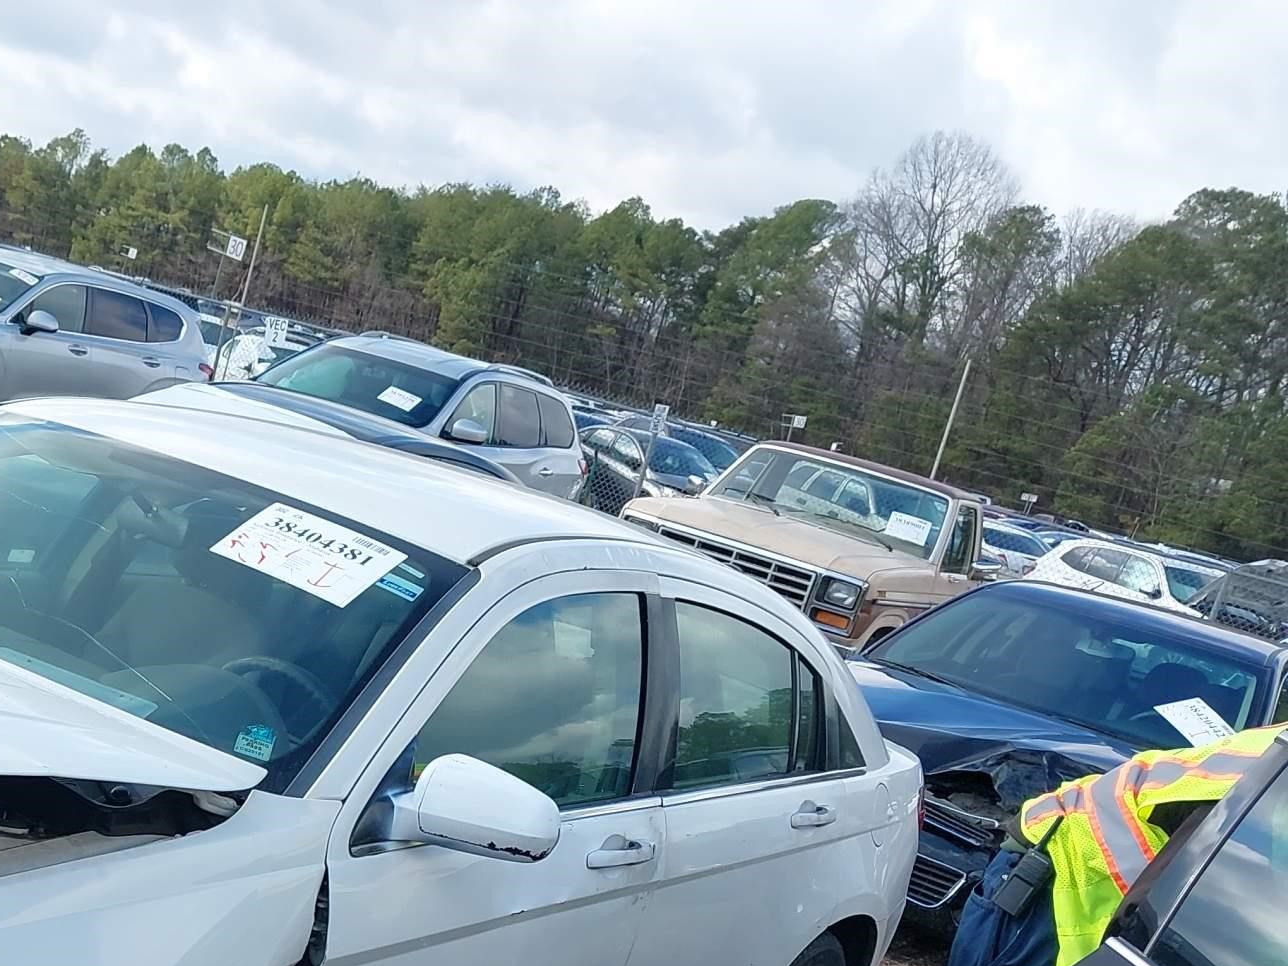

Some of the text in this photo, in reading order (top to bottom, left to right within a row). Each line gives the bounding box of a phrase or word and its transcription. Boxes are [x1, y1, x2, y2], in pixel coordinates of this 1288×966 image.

[228, 239, 245, 258] 30
[271, 332, 279, 343] 2
[264, 517, 374, 566] 38404381
